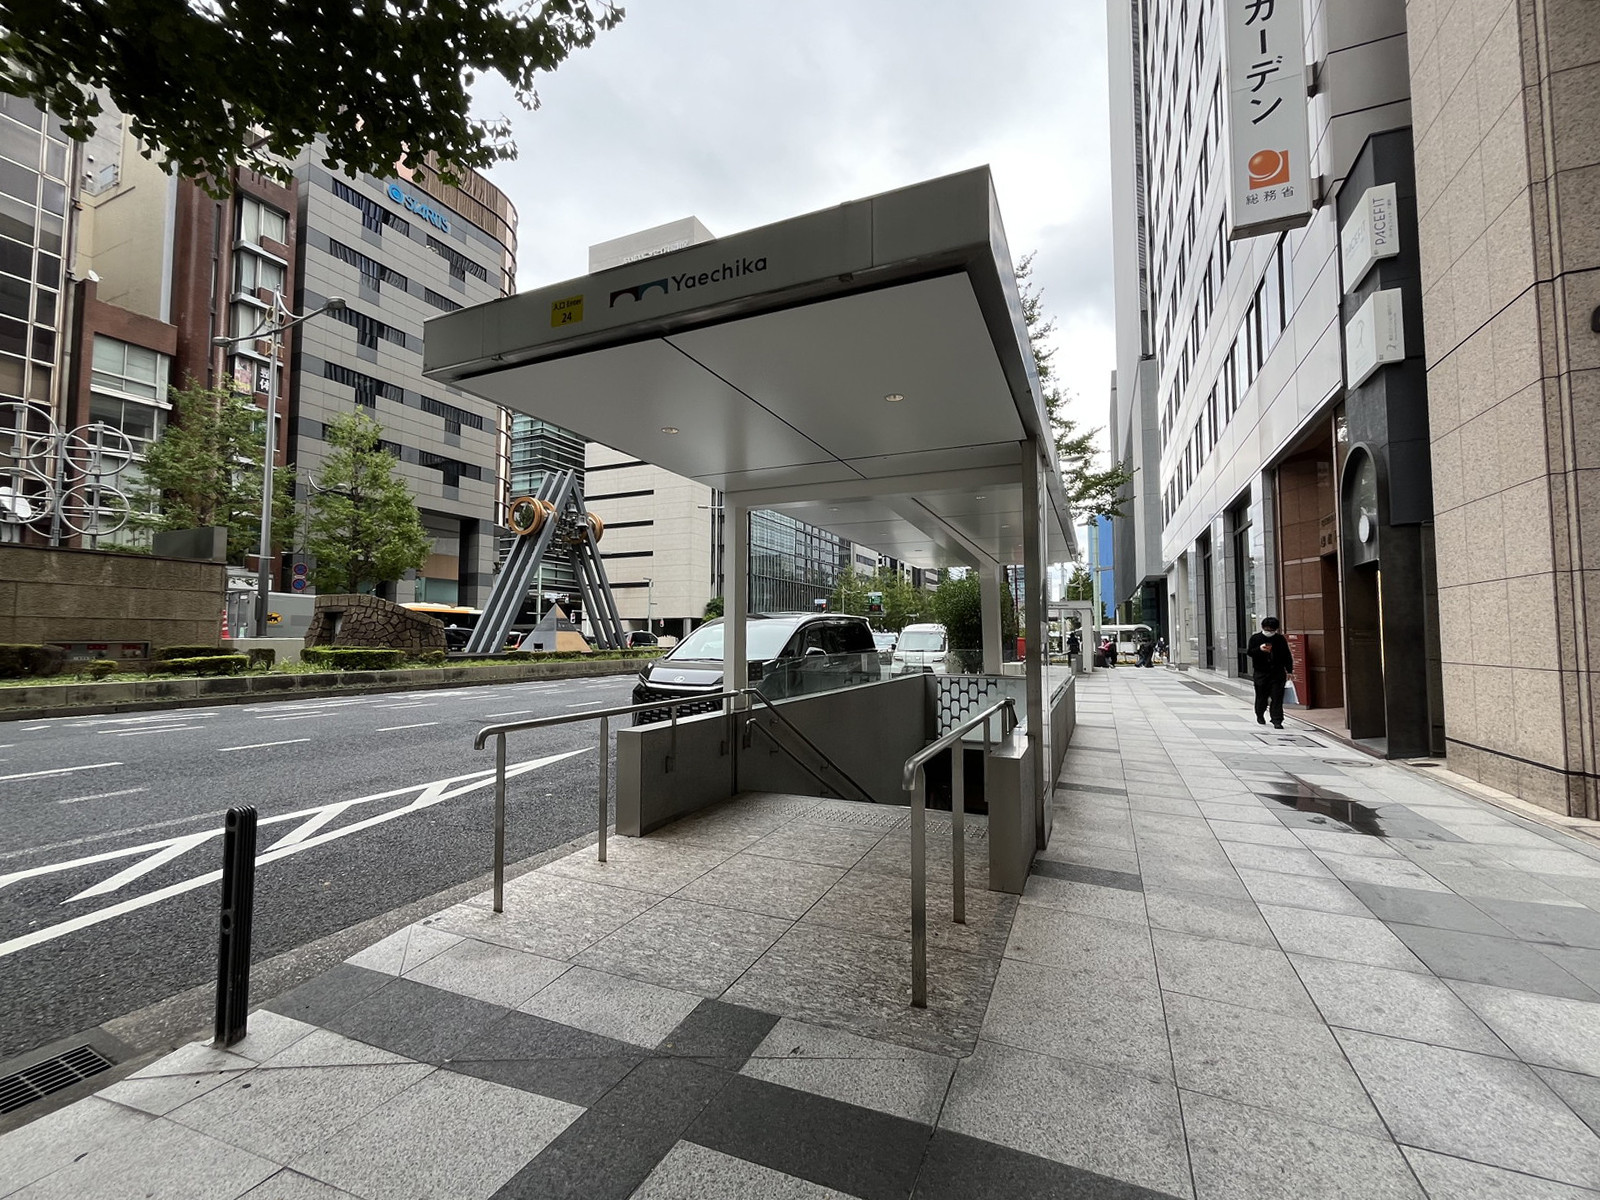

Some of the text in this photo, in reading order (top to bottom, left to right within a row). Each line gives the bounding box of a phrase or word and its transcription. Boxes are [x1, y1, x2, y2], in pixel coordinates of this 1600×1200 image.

[1245, 186, 1294, 206] 総務省
[1373, 198, 1386, 246] PACEFIT
[671, 256, 768, 292] Yaechika
[553, 301, 566, 311] 入口
[561, 311, 572, 323] 24
